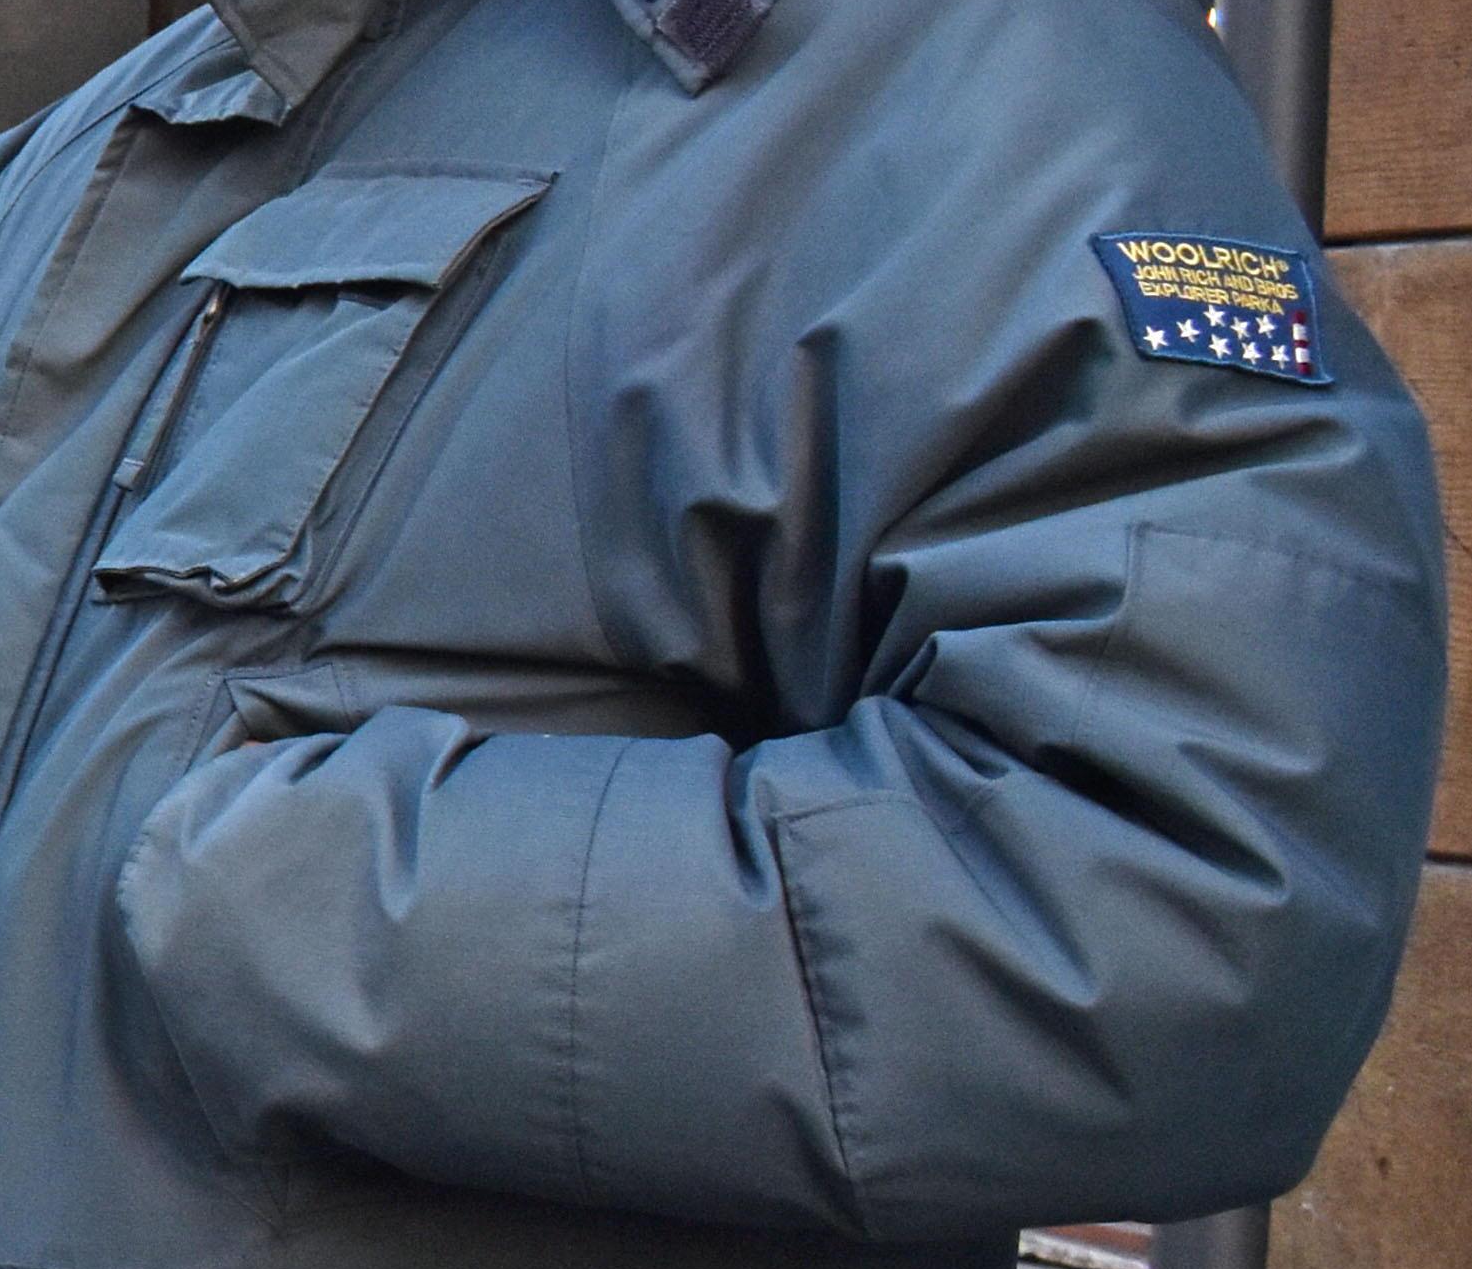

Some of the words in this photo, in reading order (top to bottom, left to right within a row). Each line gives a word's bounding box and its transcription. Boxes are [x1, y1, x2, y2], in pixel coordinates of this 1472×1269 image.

[1133, 264, 1180, 283] JOHN
[1180, 267, 1222, 288] RICH
[1224, 275, 1254, 293] AND
[1255, 278, 1299, 300] BROS
[1138, 281, 1231, 306] EXPLORER
[1232, 291, 1285, 315] PARKA
